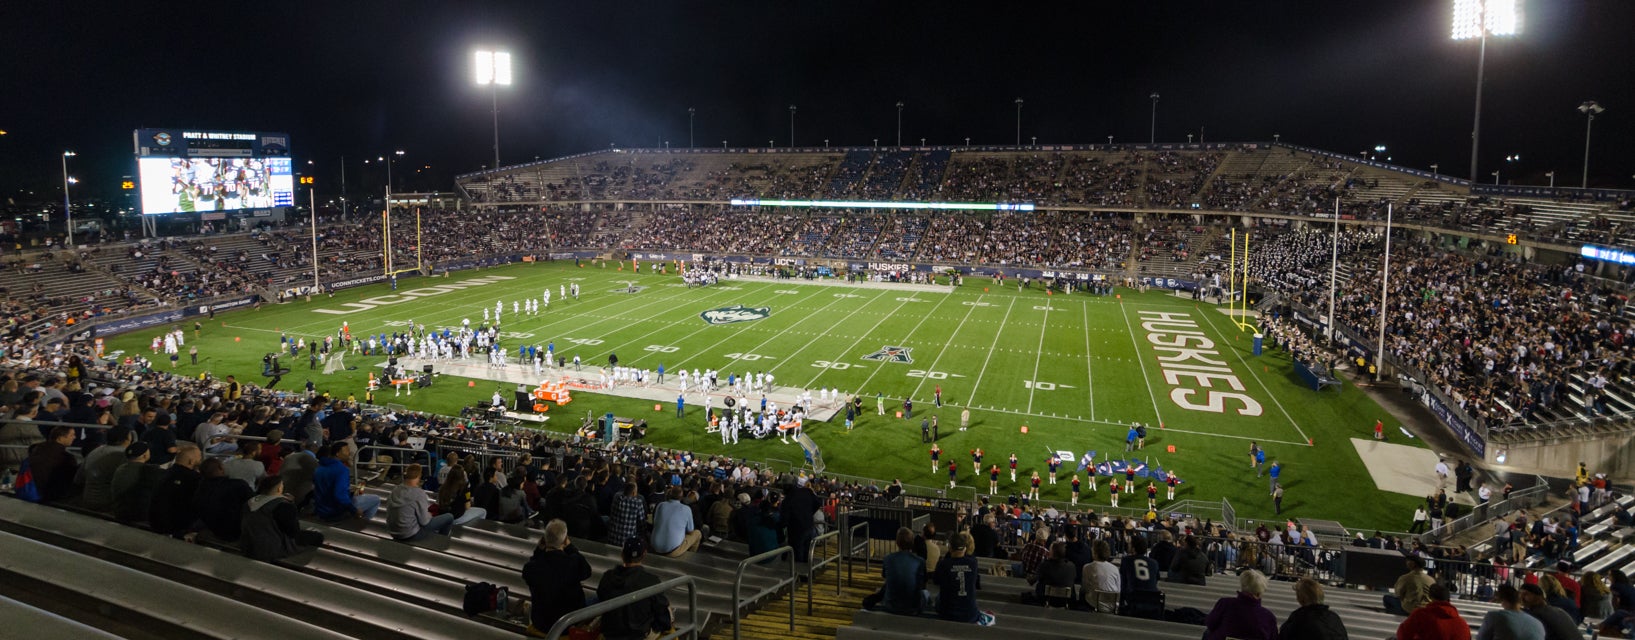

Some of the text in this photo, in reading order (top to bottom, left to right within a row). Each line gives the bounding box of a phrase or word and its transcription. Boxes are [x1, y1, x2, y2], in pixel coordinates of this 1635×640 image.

[122, 181, 135, 189] 25
[1507, 234, 1517, 245] 25
[868, 262, 909, 272] HUSKIES
[311, 275, 518, 315] UCONN
[569, 338, 606, 346] 40
[643, 344, 681, 353] 50
[723, 352, 762, 361] 40
[810, 360, 851, 370] 30
[1137, 310, 1264, 418] HUSKIES
[906, 369, 948, 380] 20
[1023, 380, 1056, 391] 10
[1133, 559, 1151, 581] 6
[955, 571, 968, 596] 1
